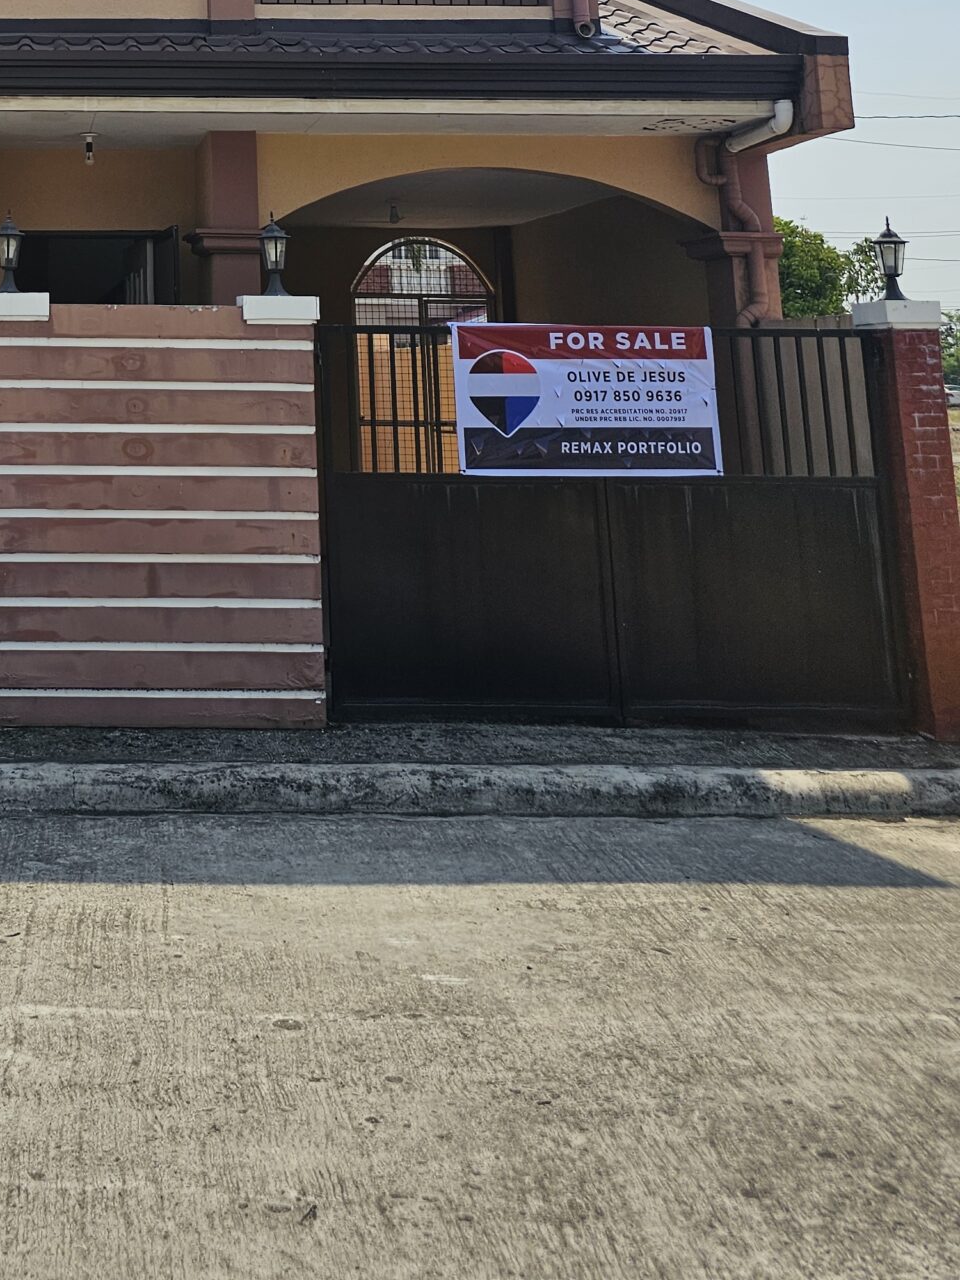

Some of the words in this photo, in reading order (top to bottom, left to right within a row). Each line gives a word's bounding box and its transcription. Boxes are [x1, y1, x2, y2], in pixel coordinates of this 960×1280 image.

[549, 332, 605, 350] FOR
[615, 332, 687, 350] SALE
[567, 371, 611, 383] OLIVE
[617, 371, 636, 383] DE
[641, 371, 686, 383] JESUS
[574, 390, 608, 402] 0917
[613, 390, 641, 402] 850
[646, 390, 682, 402] 9636
[561, 441, 613, 454] REMAX
[617, 441, 702, 454] PORTFOLIO
